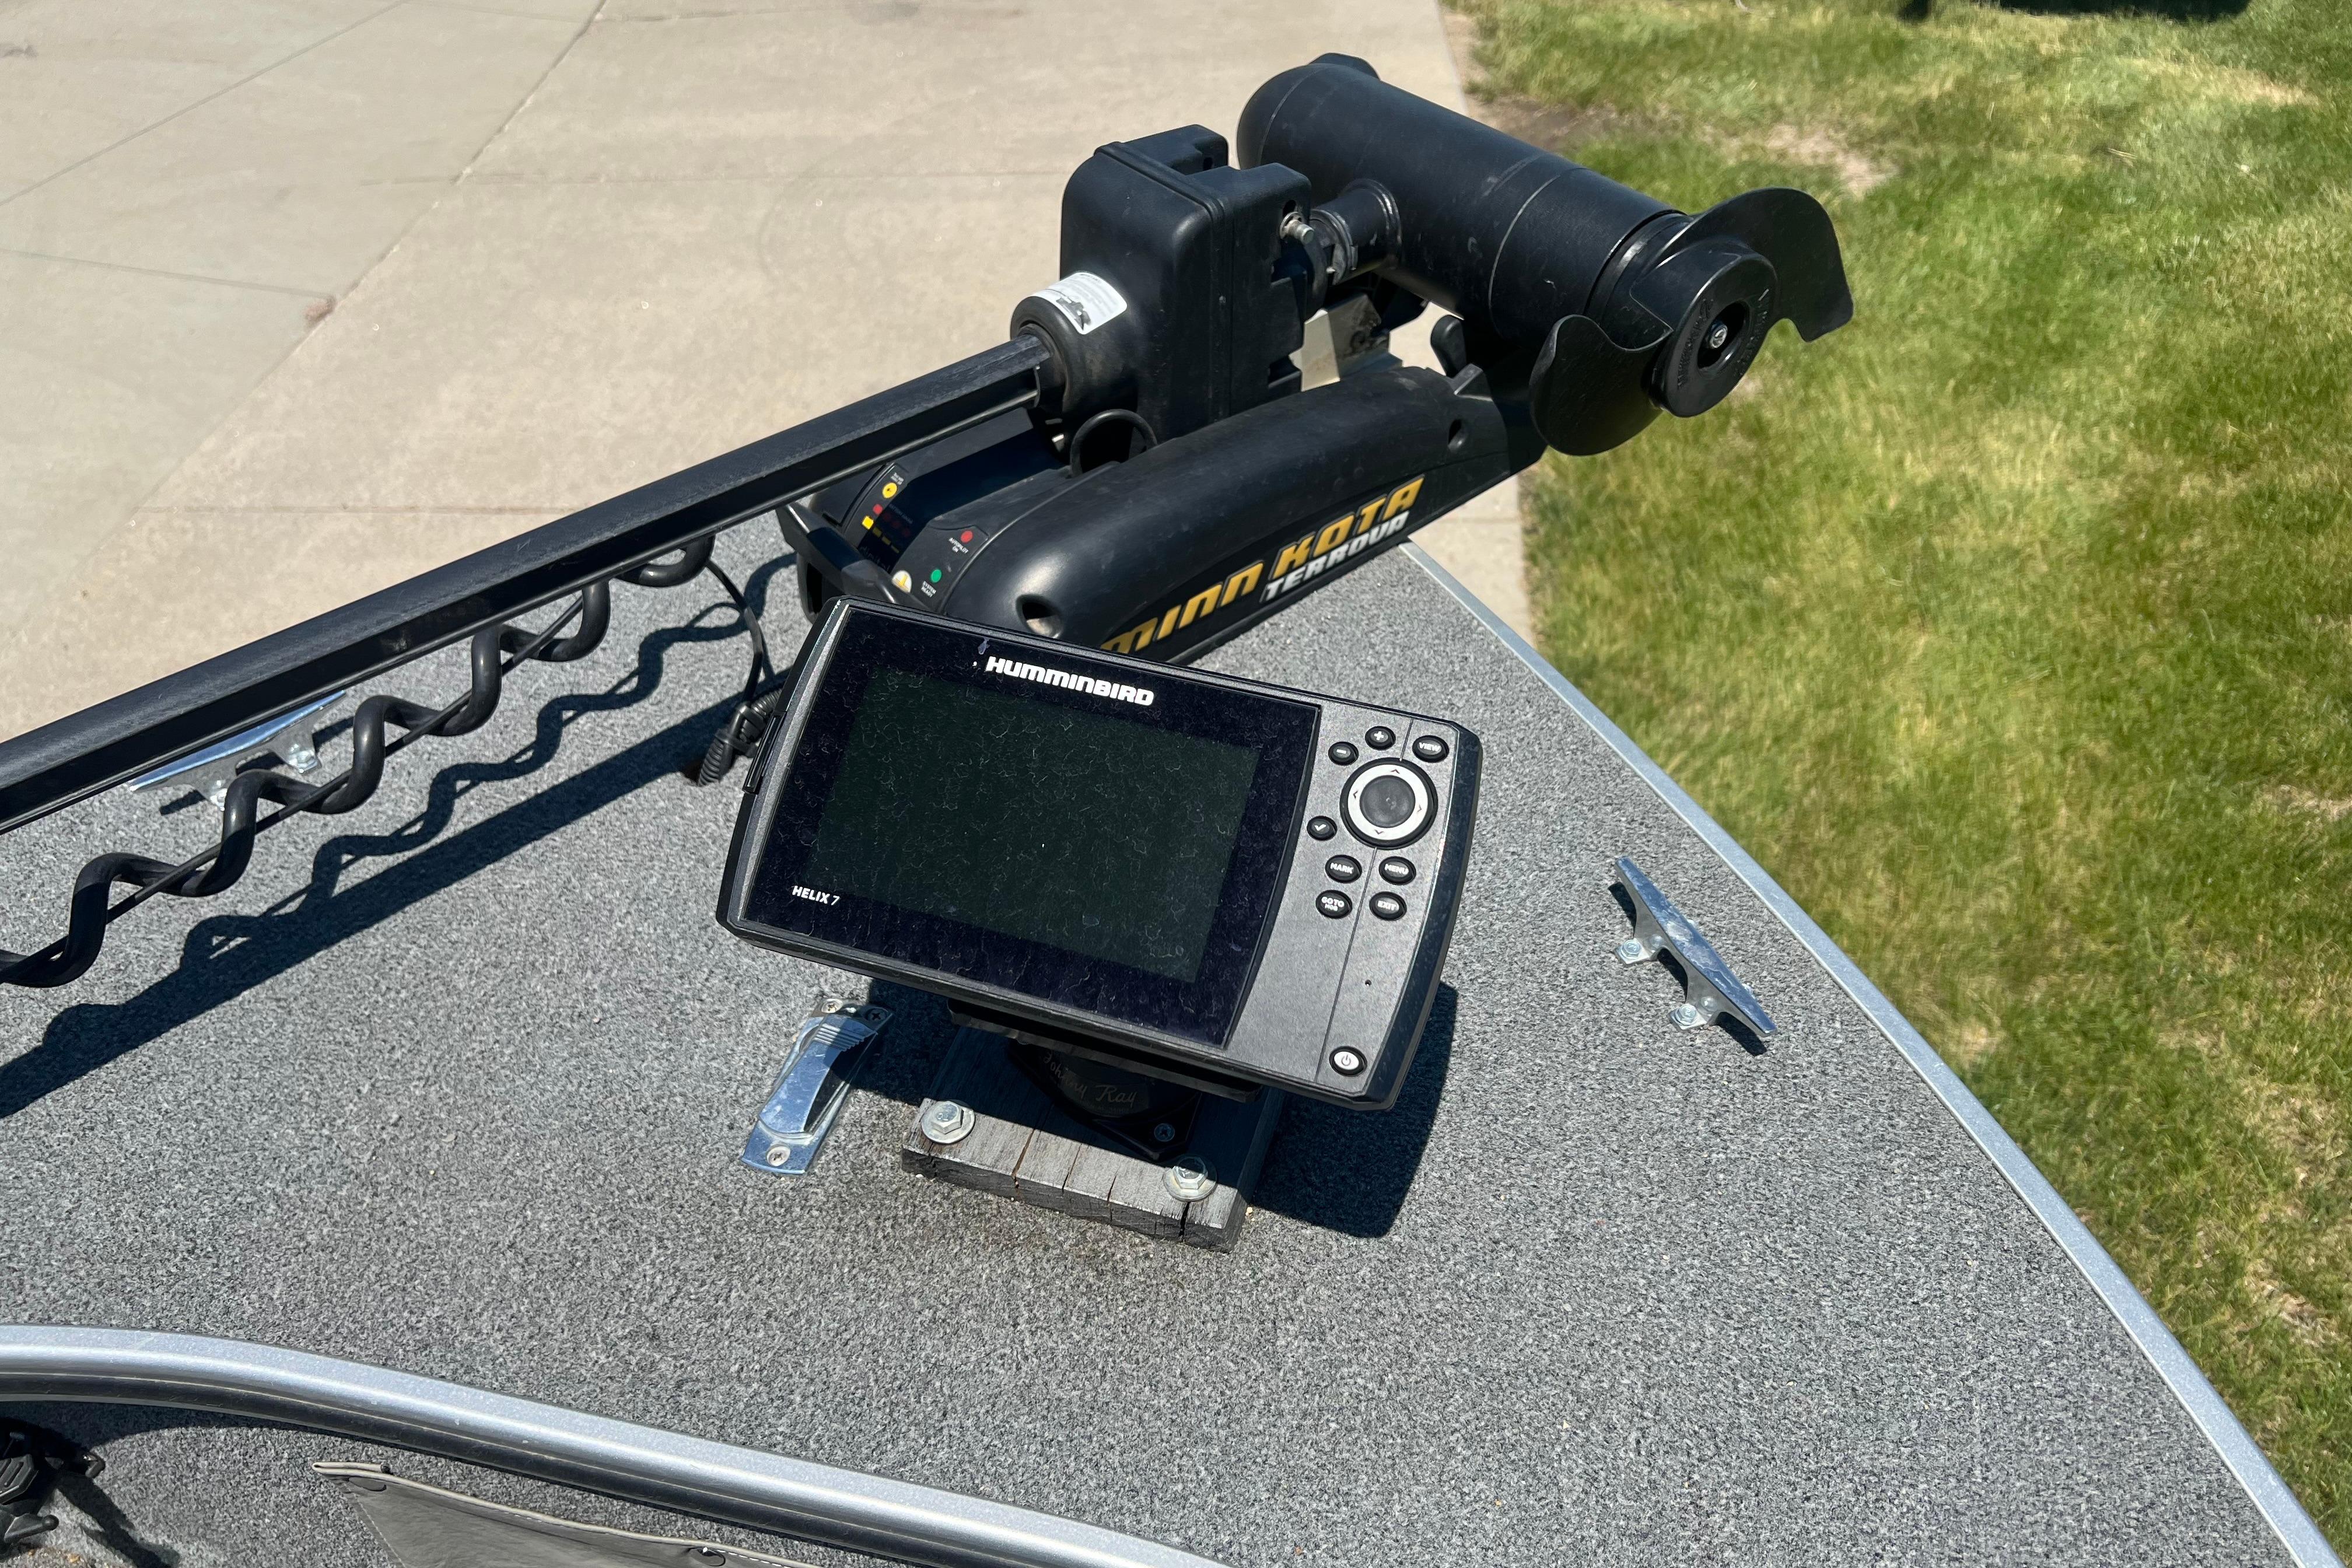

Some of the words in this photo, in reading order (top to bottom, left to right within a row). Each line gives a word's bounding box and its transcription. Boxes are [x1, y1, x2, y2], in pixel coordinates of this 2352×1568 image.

[1272, 476, 1424, 580] KOTA
[1265, 510, 1410, 601] TERROVA
[985, 656, 1154, 706] HUMMINBIRD
[1418, 741, 1441, 752] VIEW
[1330, 862, 1354, 874] MARK
[1384, 863, 1409, 876] MENU
[792, 885, 830, 904] HELIX
[831, 894, 841, 906] 7
[1377, 900, 1398, 911] EXIT
[1042, 1049, 1088, 1100] Johnny
[1094, 1084, 1137, 1108] Ray
